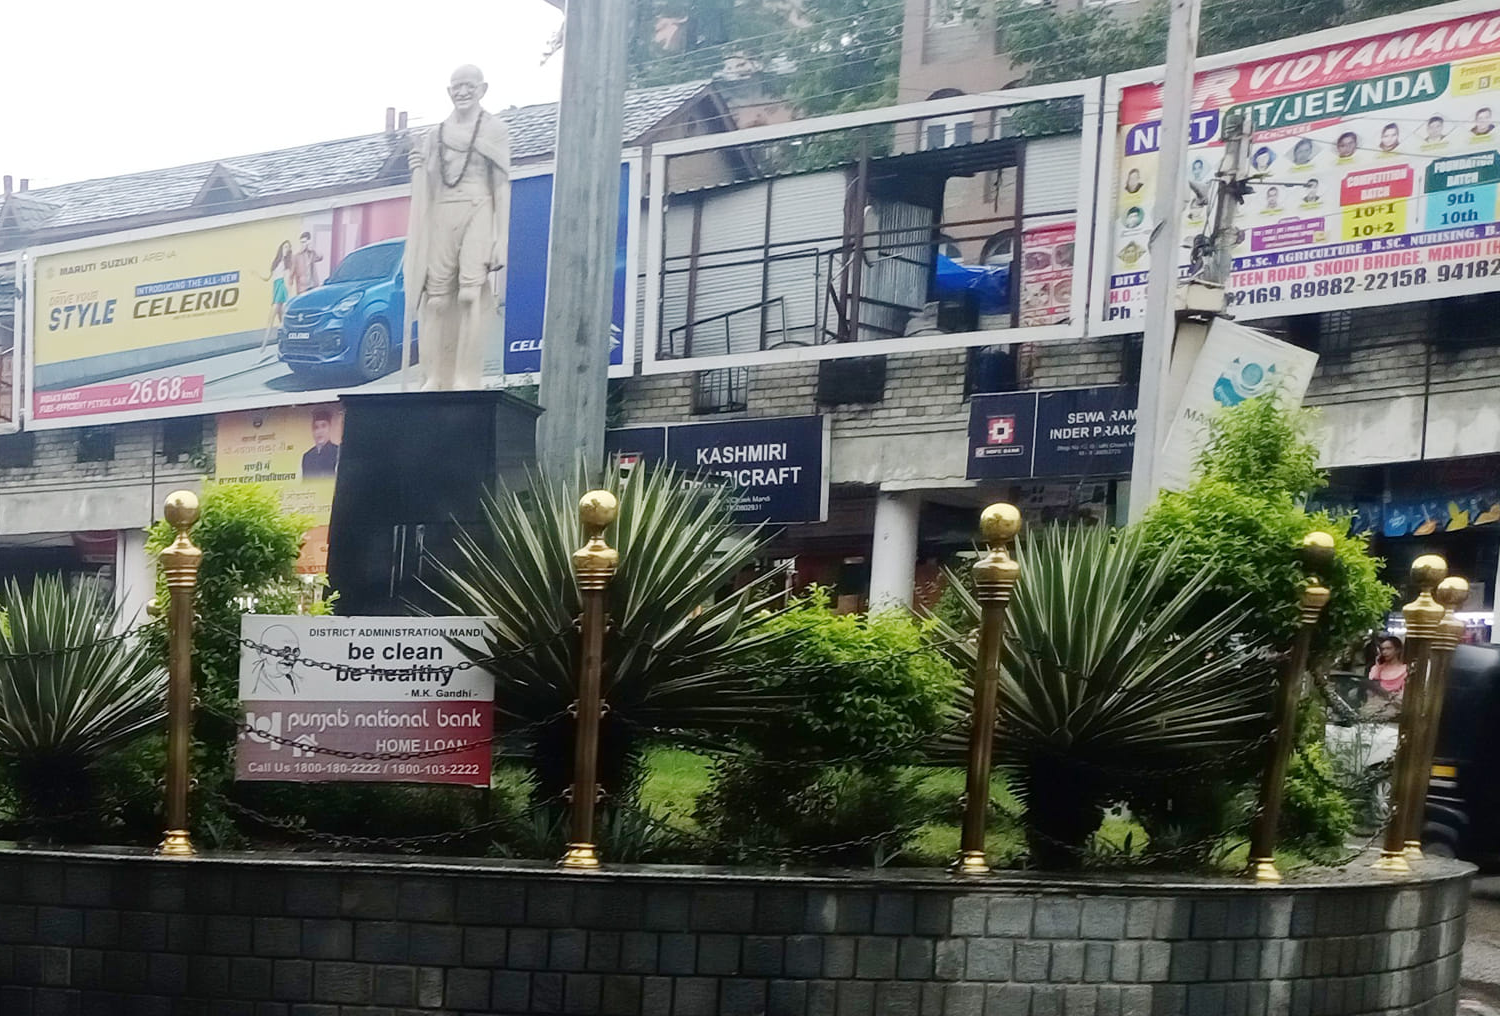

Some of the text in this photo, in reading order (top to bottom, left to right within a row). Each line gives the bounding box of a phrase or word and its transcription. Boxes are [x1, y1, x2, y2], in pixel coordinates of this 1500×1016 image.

[1133, 116, 1213, 151] NT
[1447, 191, 1475, 206] 9th
[1352, 202, 1396, 219] 10+1
[1440, 209, 1478, 225] 10th
[1352, 222, 1395, 238] 10+2
[59, 262, 97, 276] MARUTI
[100, 255, 139, 270] SUZUKI
[1314, 257, 1360, 278] SKODI
[1428, 242, 1482, 262] MANDI
[136, 273, 238, 296] INTRODUCING THE ALL-NEW
[133, 287, 240, 319] CELERIO
[49, 299, 117, 331] STYLE
[1067, 411, 1105, 425] SEWA
[1050, 427, 1089, 440] INDER
[696, 443, 787, 465] KASHMIRI
[309, 628, 484, 637] DISTRICT ADMINISTRATION MANDI
[348, 642, 443, 660] be clean
[336, 664, 453, 687] be healthy
[435, 689, 472, 698] Gandhi
[288, 708, 481, 732] punjab national bank
[376, 739, 467, 752] HOME LOAN
[248, 762, 271, 774] Call
[274, 762, 291, 774] Us
[293, 762, 381, 774] 1800-180-2222
[391, 763, 480, 776] 1800-103-2222
